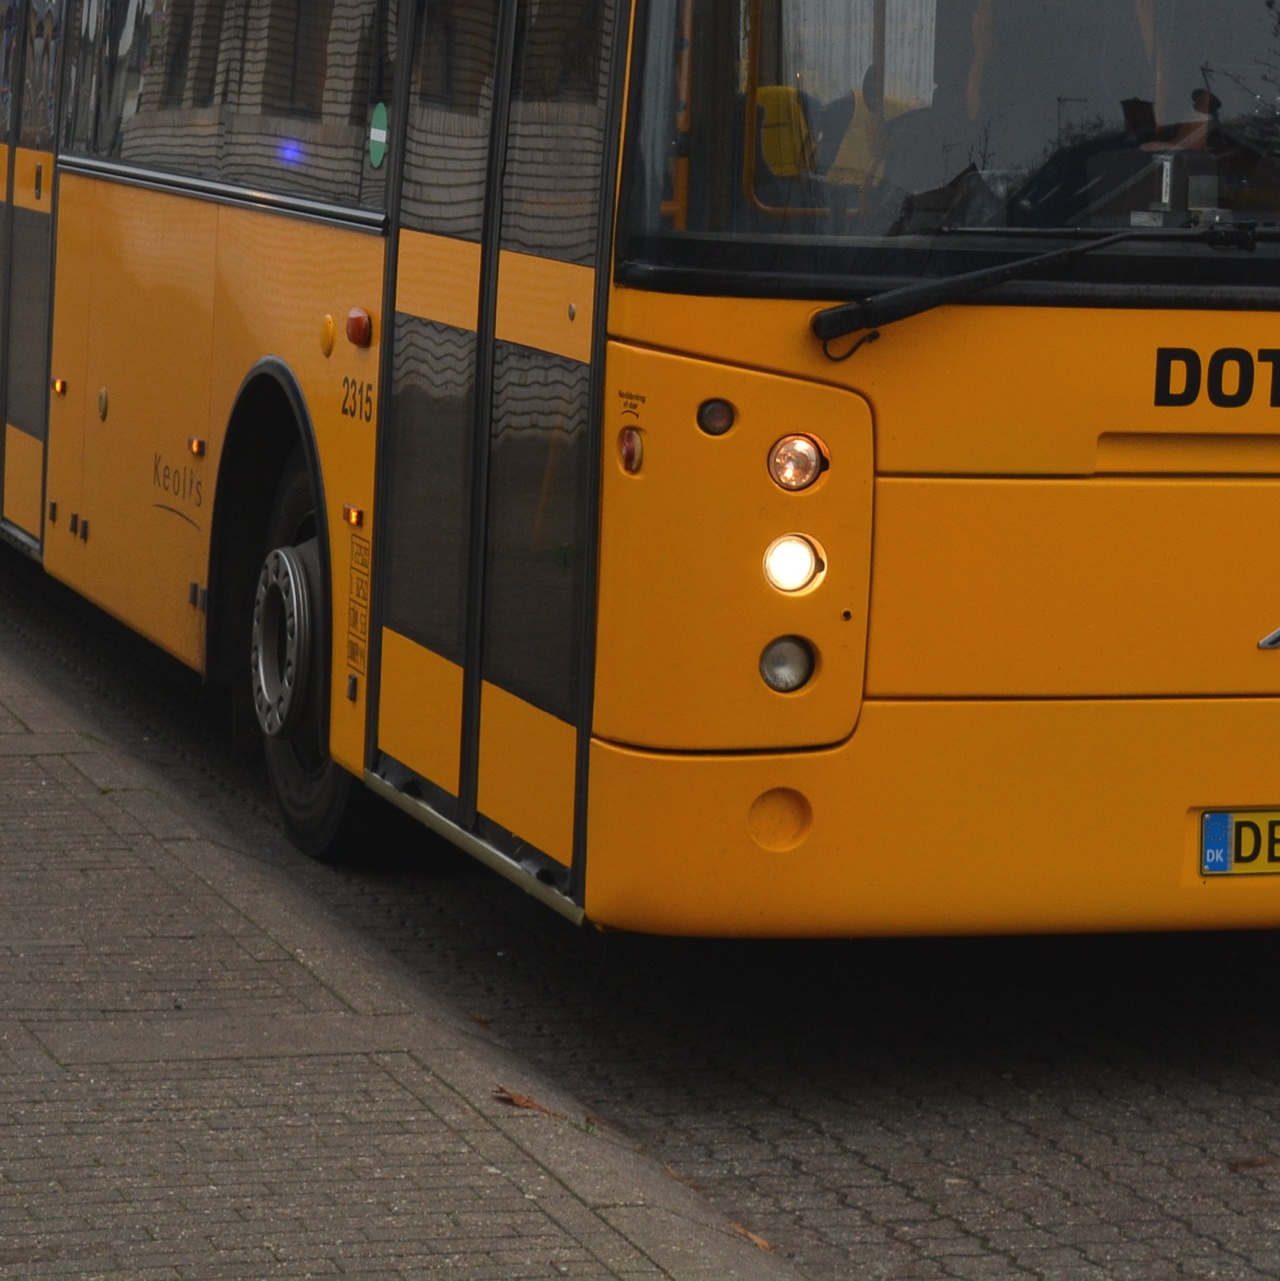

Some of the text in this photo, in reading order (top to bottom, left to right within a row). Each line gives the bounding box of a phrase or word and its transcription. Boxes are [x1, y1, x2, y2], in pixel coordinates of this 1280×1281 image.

[341, 376, 372, 423] 2315
[153, 452, 202, 507] Keolis
[1206, 849, 1224, 863] DK
